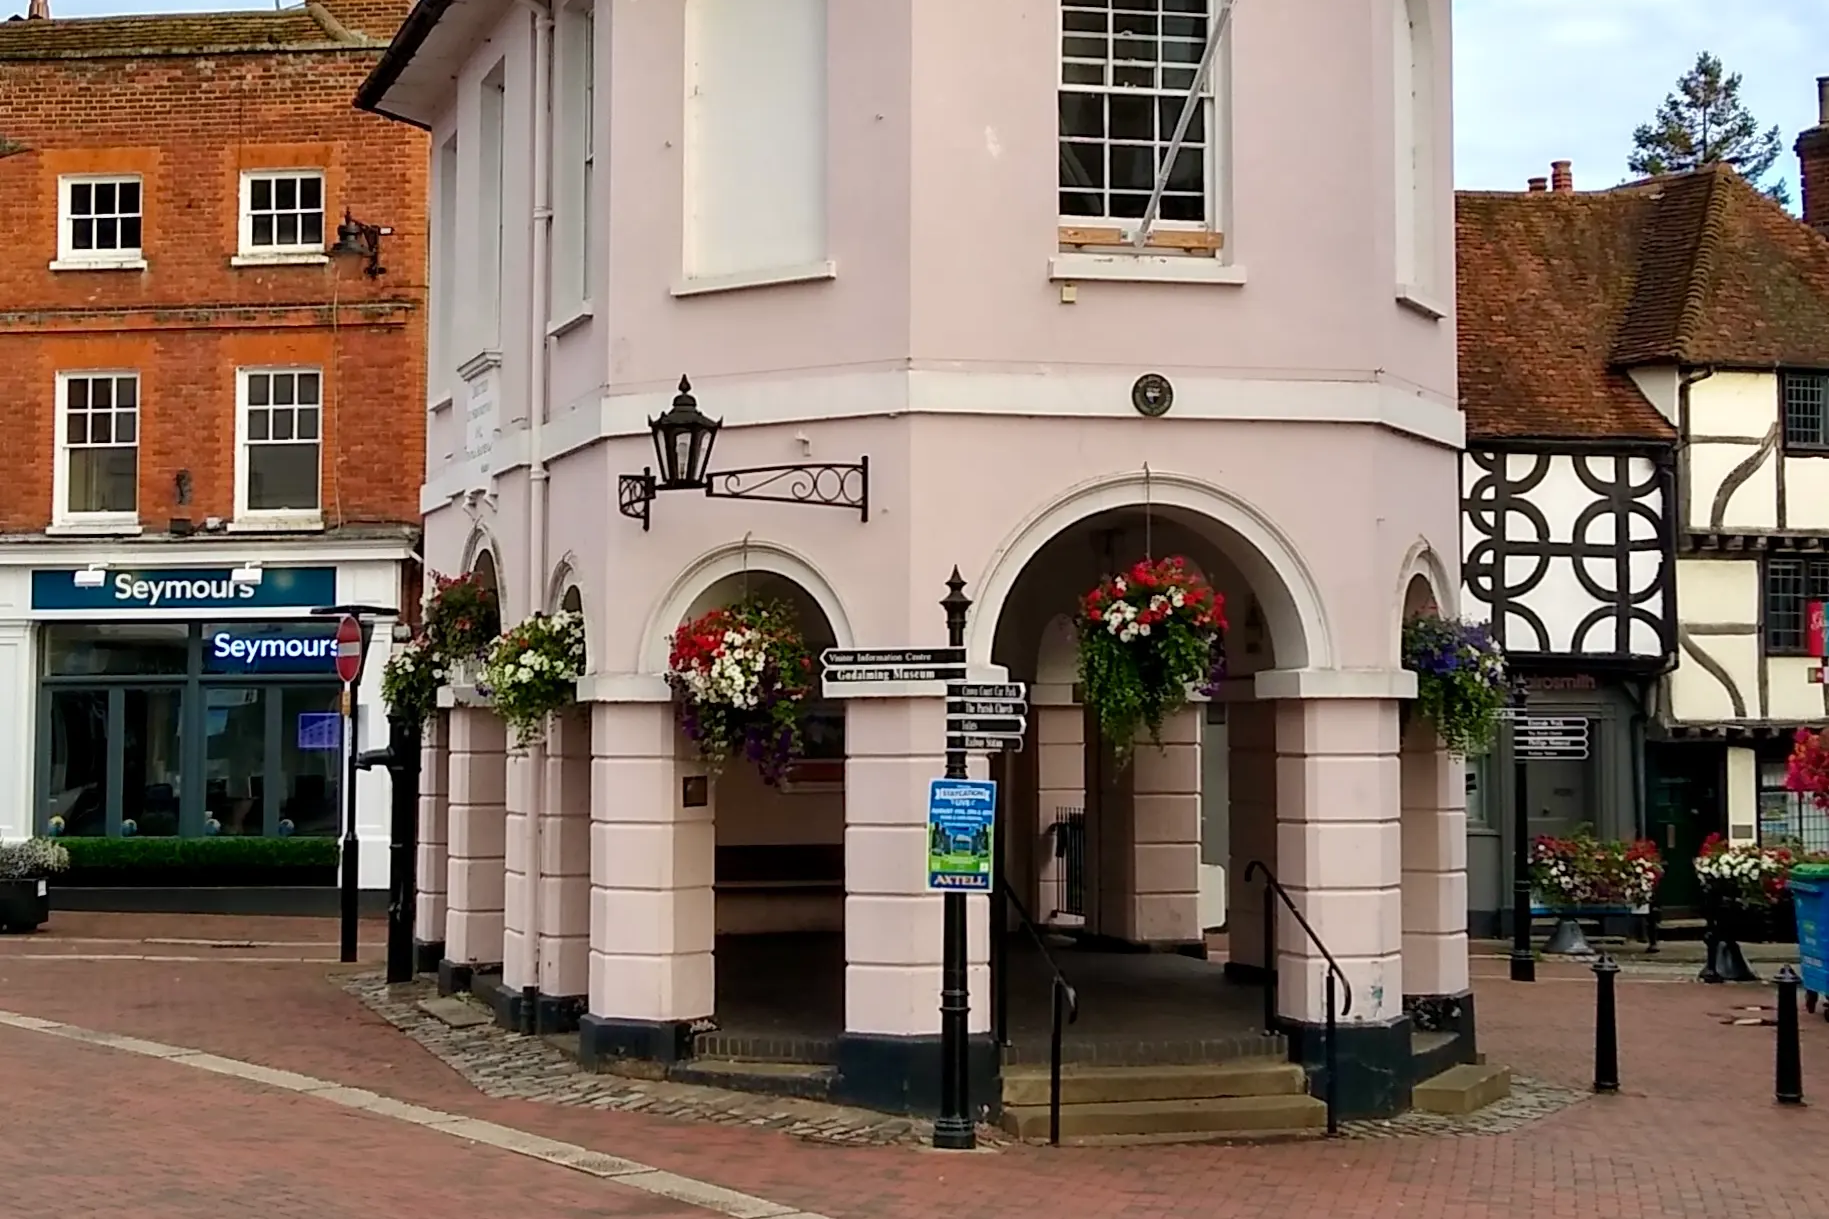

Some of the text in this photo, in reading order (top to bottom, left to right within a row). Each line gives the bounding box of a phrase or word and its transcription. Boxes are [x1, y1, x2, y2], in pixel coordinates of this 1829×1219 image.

[115, 574, 255, 605] Seymours
[857, 653, 902, 662] Information
[905, 652, 932, 661] Centre
[837, 668, 935, 681] Godalming Museum
[933, 875, 987, 886] AXTELL
